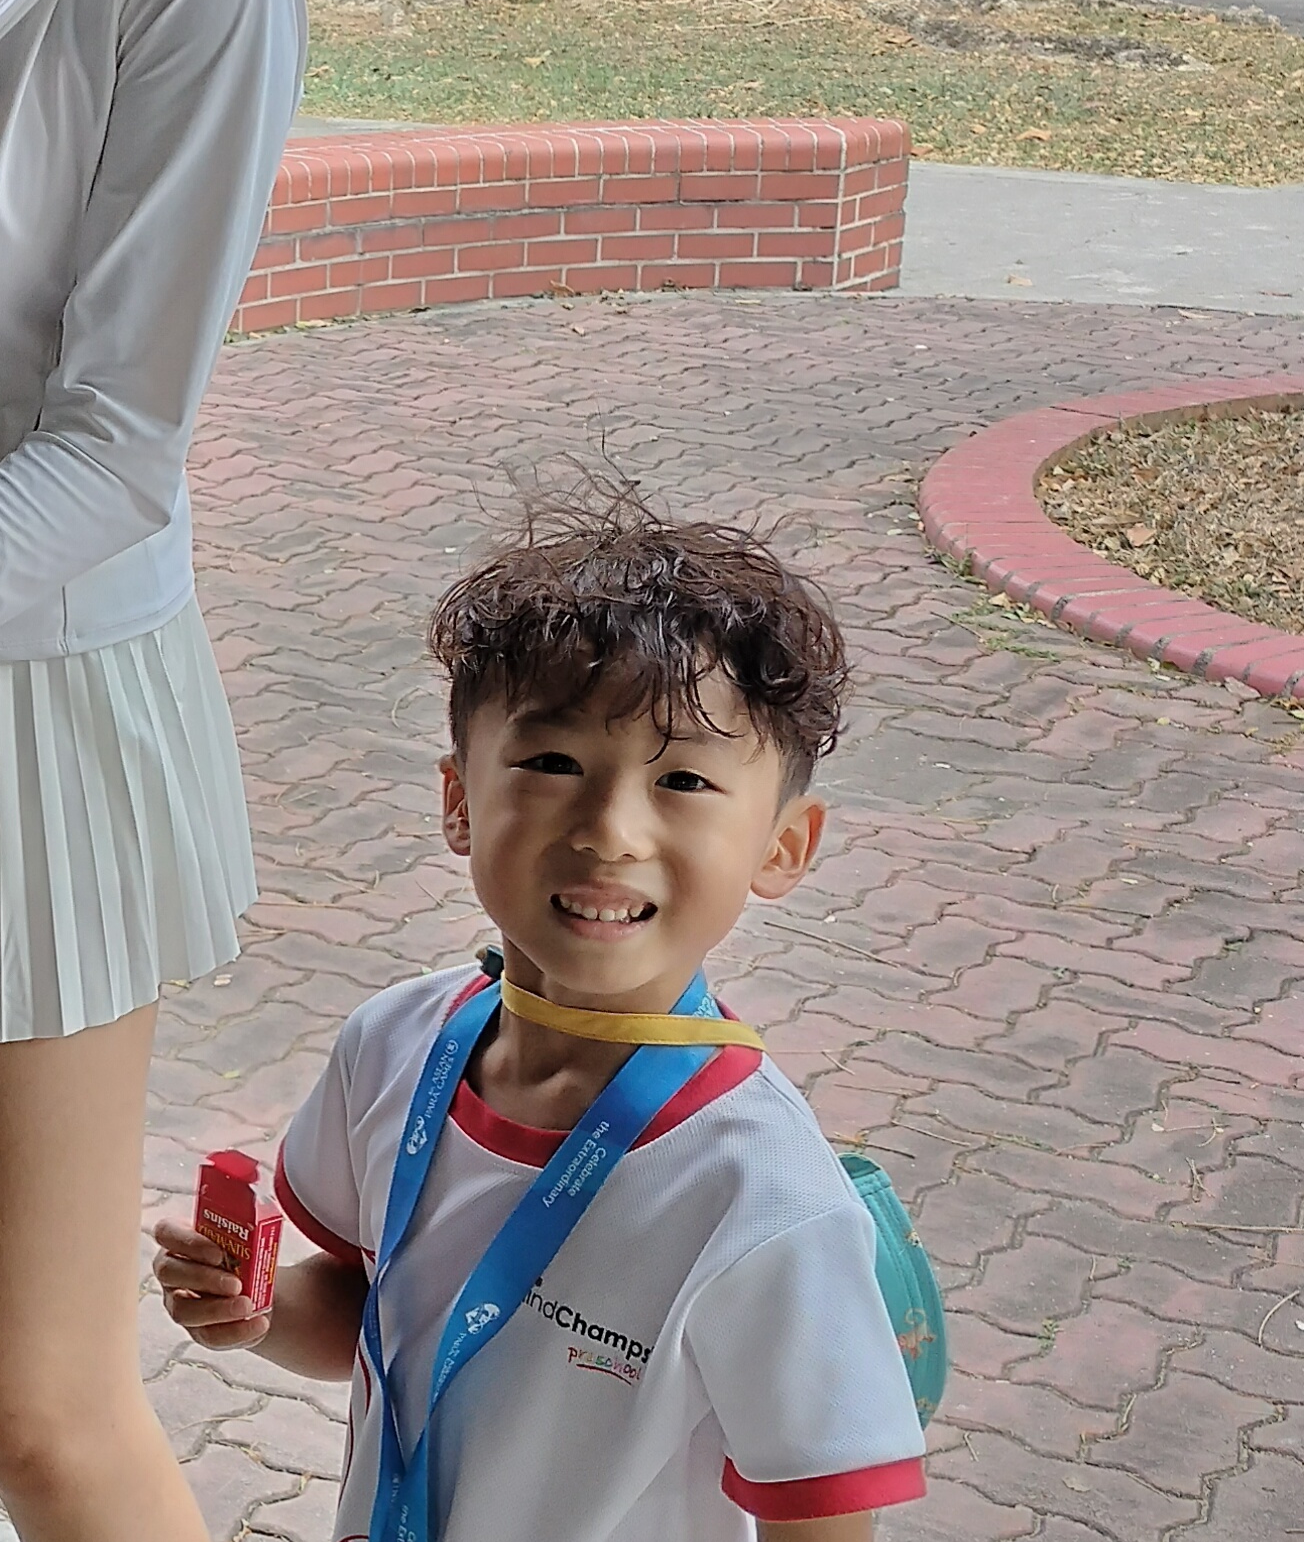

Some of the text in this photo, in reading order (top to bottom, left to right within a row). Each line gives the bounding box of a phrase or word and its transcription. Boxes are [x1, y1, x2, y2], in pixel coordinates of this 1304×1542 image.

[432, 1053, 449, 1083] ASIAN
[542, 1120, 610, 1208] the Extraordinary
[566, 1147, 607, 1197] Celebrate
[203, 1208, 250, 1241] Raisins
